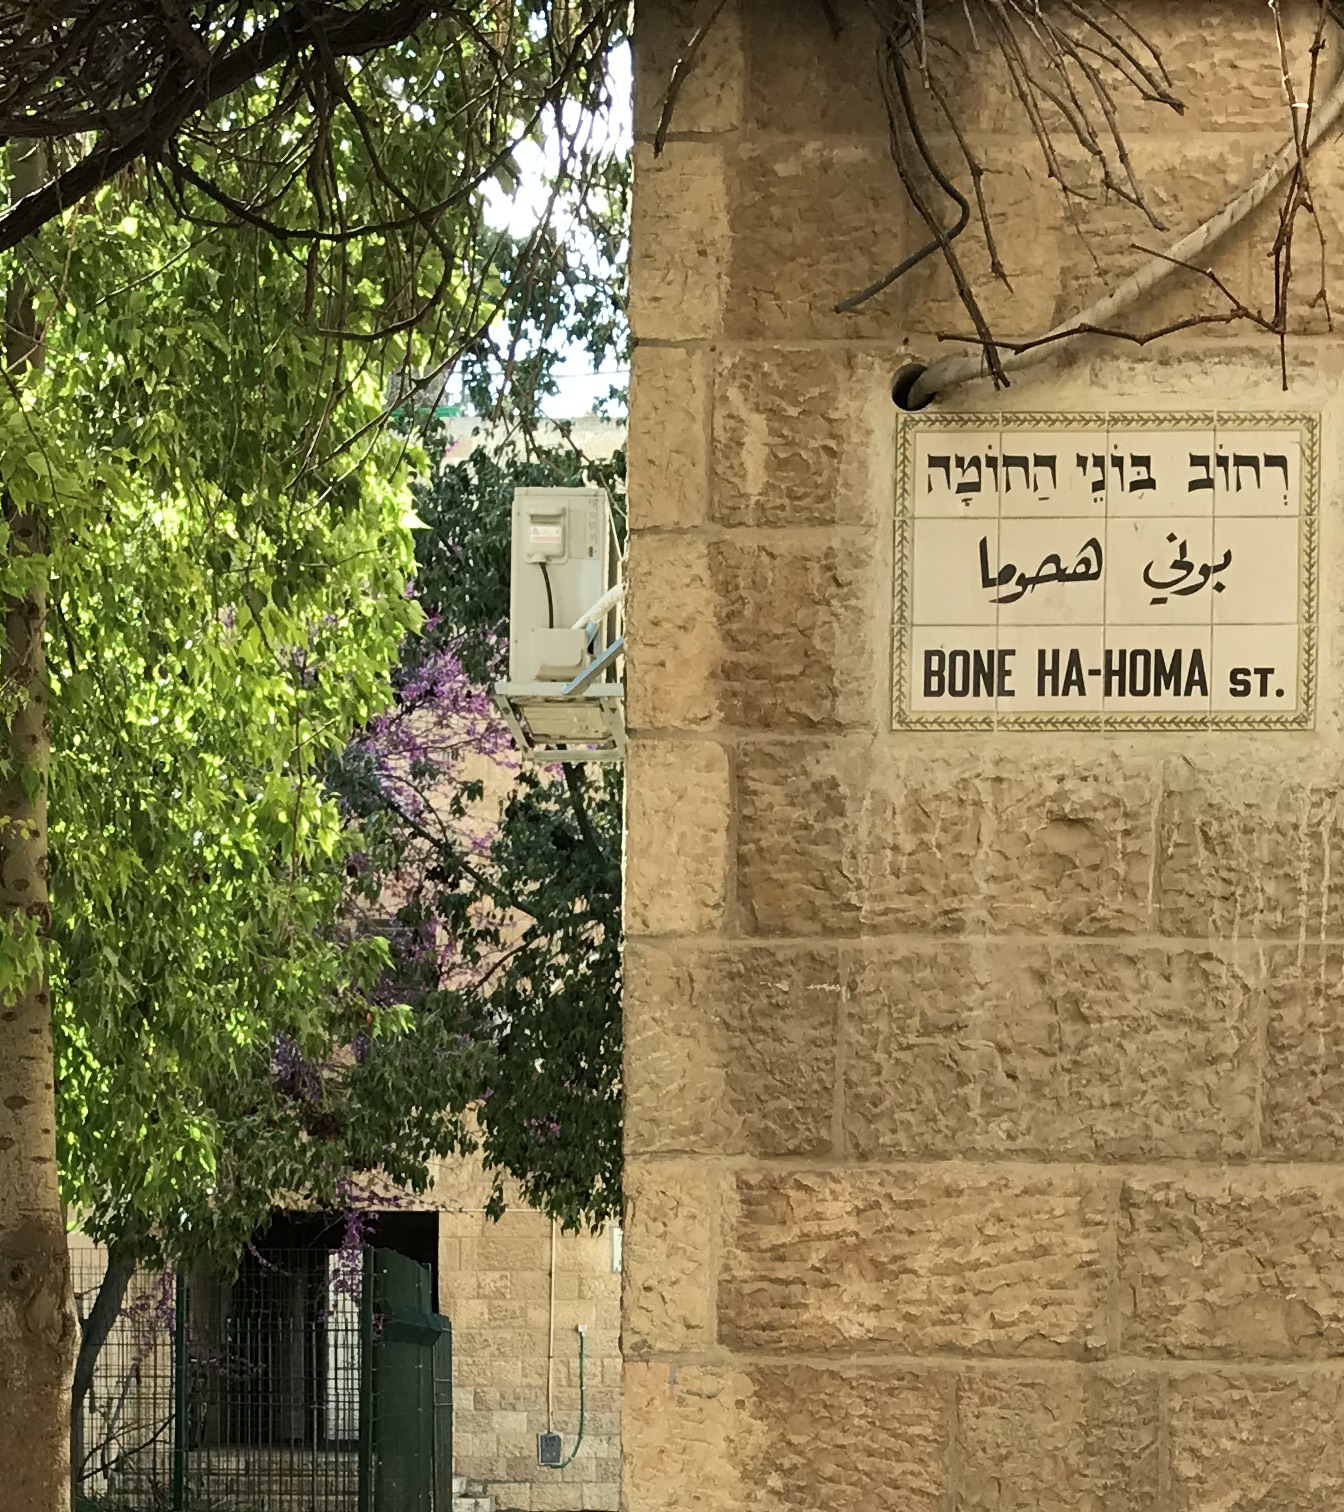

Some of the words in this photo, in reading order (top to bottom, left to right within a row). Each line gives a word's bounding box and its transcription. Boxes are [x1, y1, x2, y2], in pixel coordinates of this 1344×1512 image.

[923, 649, 1016, 697] BONE
[1037, 648, 1208, 697] HA-HOMA
[1228, 667, 1285, 698] ST.
